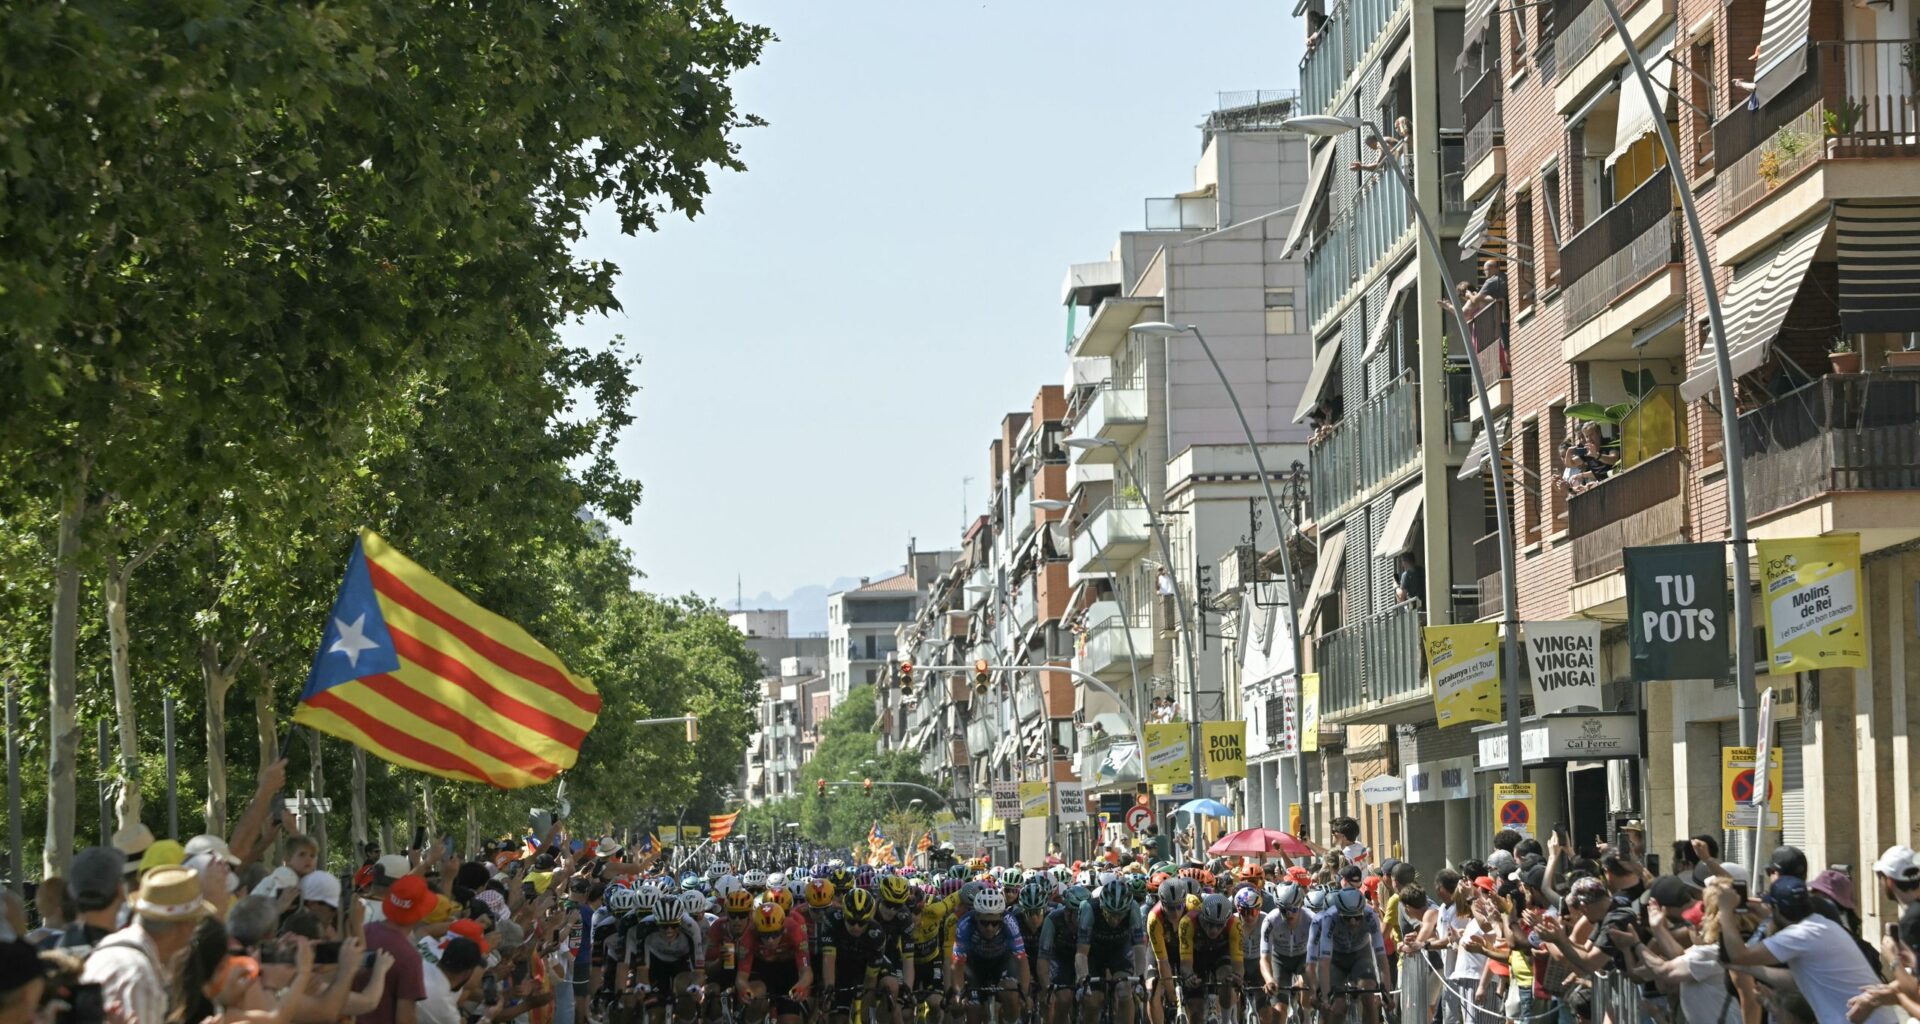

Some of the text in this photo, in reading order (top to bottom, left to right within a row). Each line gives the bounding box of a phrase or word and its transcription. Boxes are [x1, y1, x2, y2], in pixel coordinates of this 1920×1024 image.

[1655, 574, 1695, 607] TU
[1792, 584, 1830, 608] Molins
[1800, 595, 1832, 618] de Rei
[1642, 608, 1716, 643] POTS
[1532, 635, 1593, 653] VINGA!
[1535, 652, 1594, 672] VINGA!
[1438, 667, 1468, 687] Catalunya
[1538, 670, 1596, 692] VINGA!
[1210, 734, 1239, 749] BON
[1567, 740, 1618, 748] Cal Ferrer
[1209, 747, 1243, 762] TOUR
